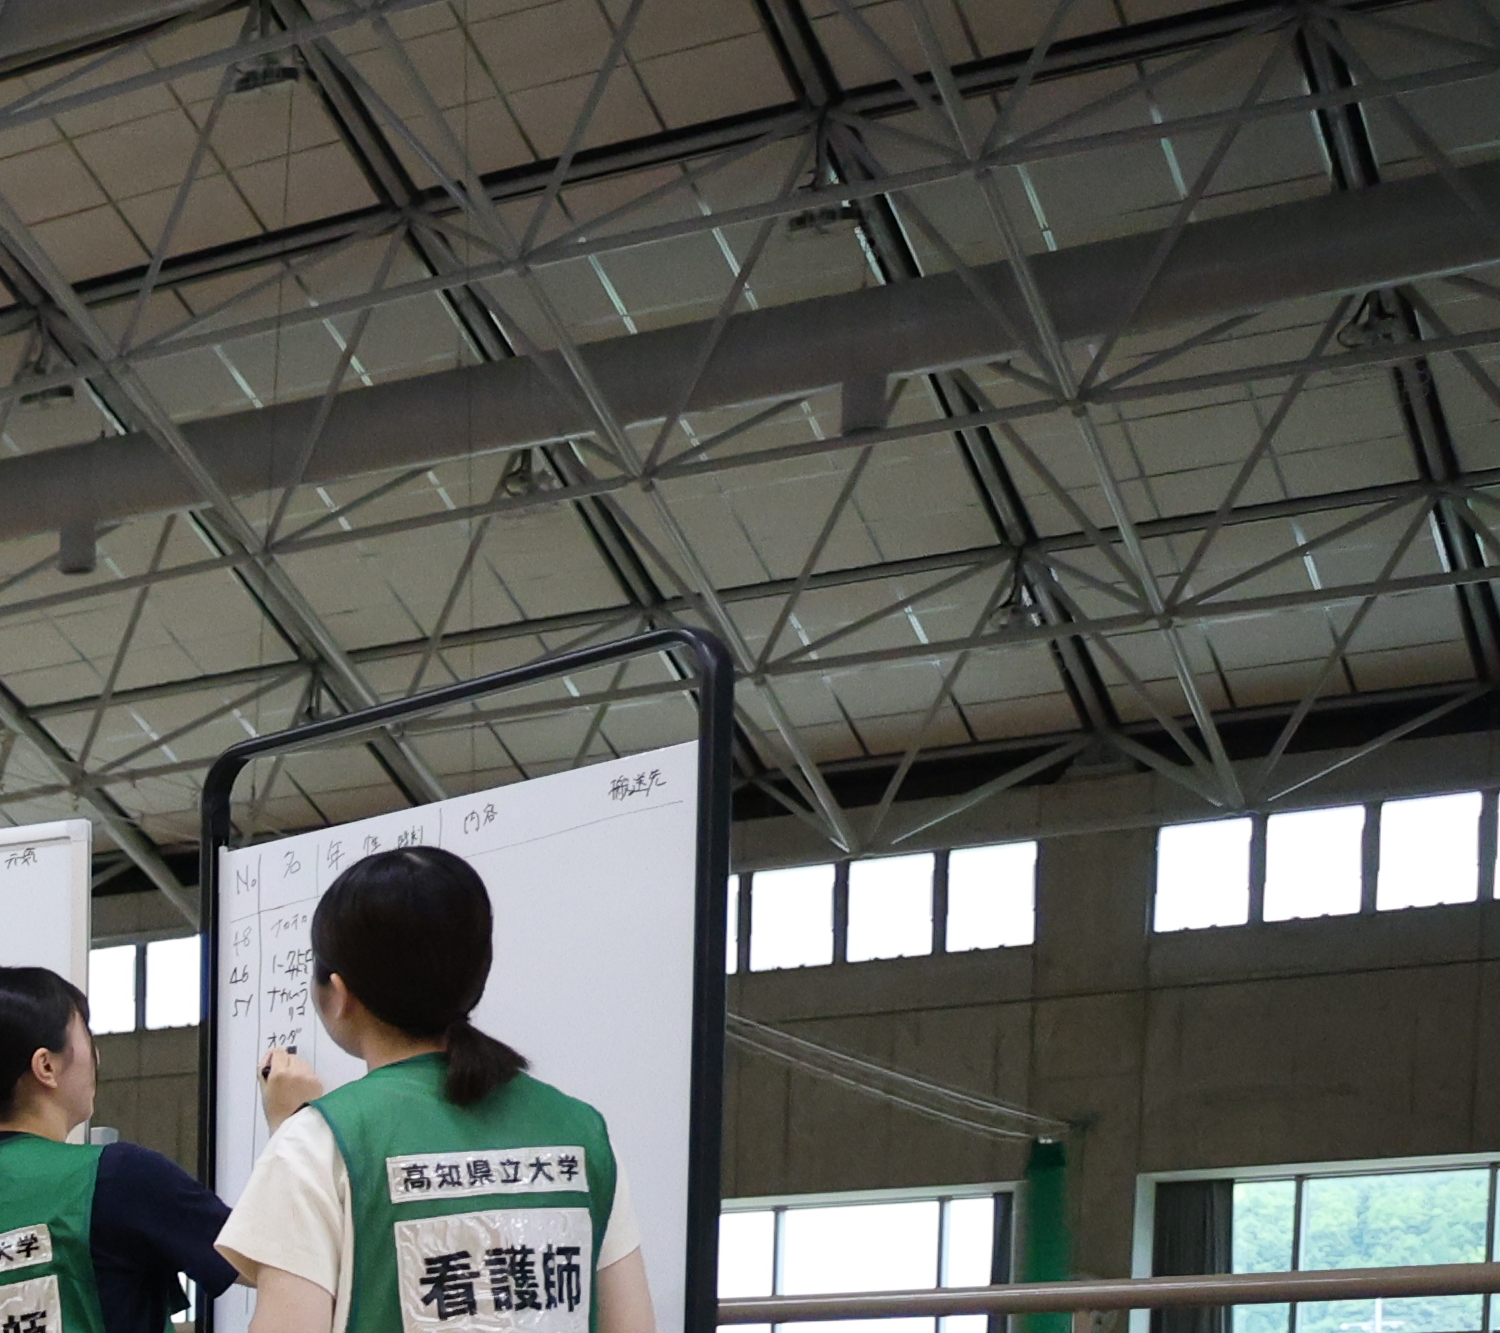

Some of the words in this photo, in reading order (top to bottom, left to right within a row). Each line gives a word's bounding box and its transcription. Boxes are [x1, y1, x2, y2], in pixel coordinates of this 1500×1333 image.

[401, 1154, 581, 1190] 高知県立大学
[419, 1243, 583, 1320] 看護師
